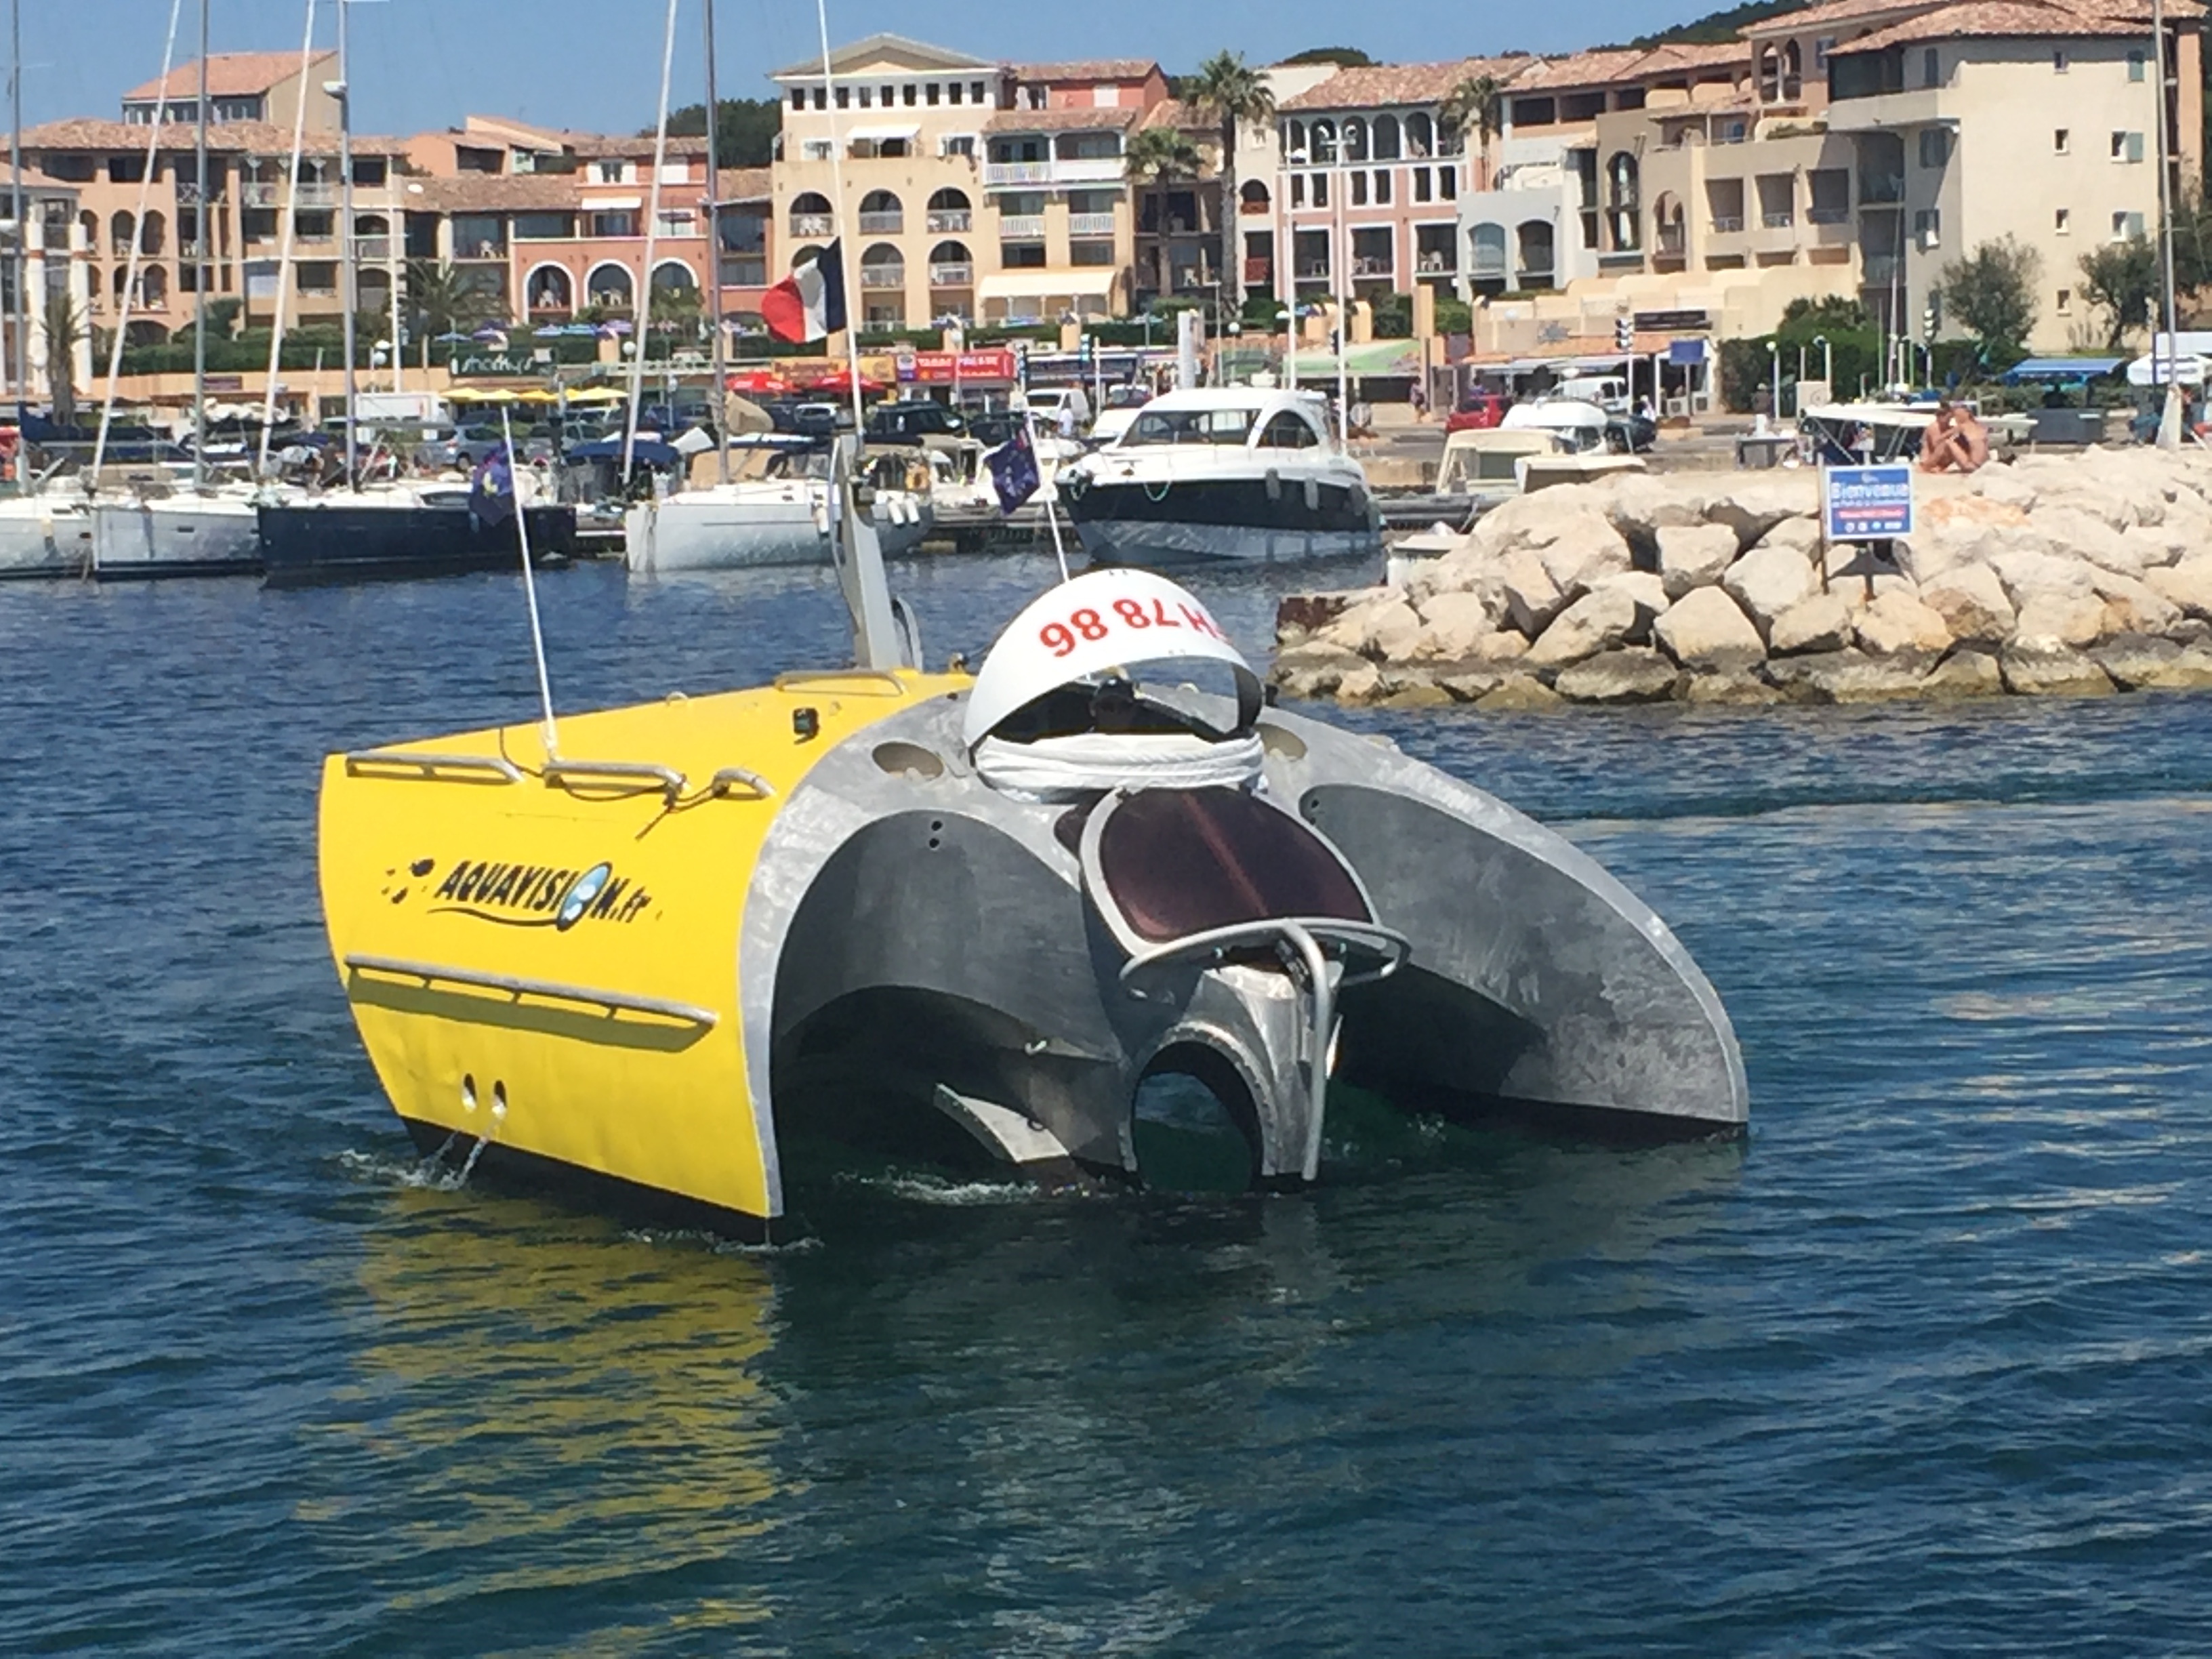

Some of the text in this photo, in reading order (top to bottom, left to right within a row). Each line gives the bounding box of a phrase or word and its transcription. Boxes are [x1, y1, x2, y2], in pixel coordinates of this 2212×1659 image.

[1039, 607, 1109, 658] 86
[1112, 598, 1181, 629] 78
[432, 861, 652, 932] AQUAVISION.fr
